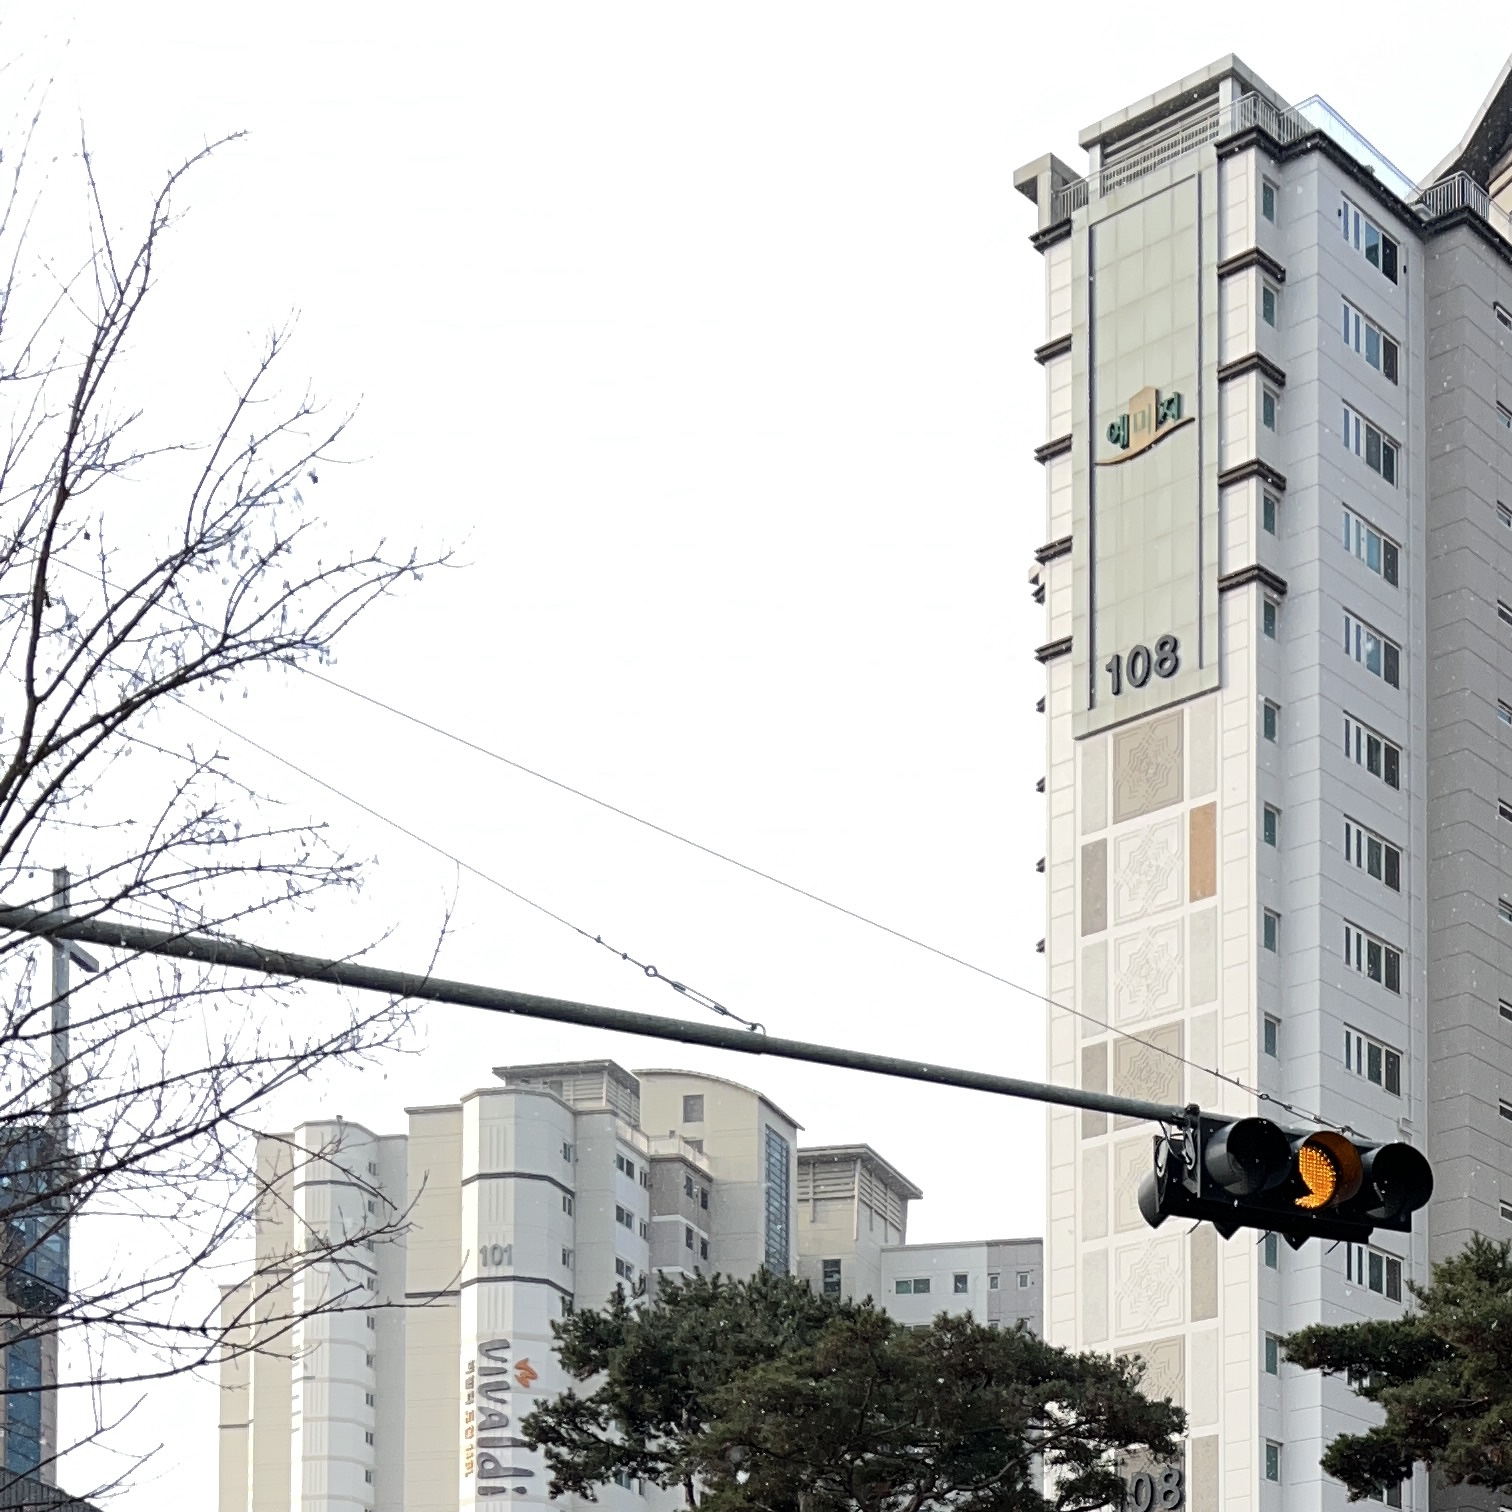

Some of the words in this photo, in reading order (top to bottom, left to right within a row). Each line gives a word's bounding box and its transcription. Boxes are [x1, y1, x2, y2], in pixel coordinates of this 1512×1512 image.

[1106, 391, 1182, 450] 예미지
[1106, 634, 1178, 697] 108
[480, 1243, 513, 1267] 101
[477, 1338, 537, 1496] vivaldi
